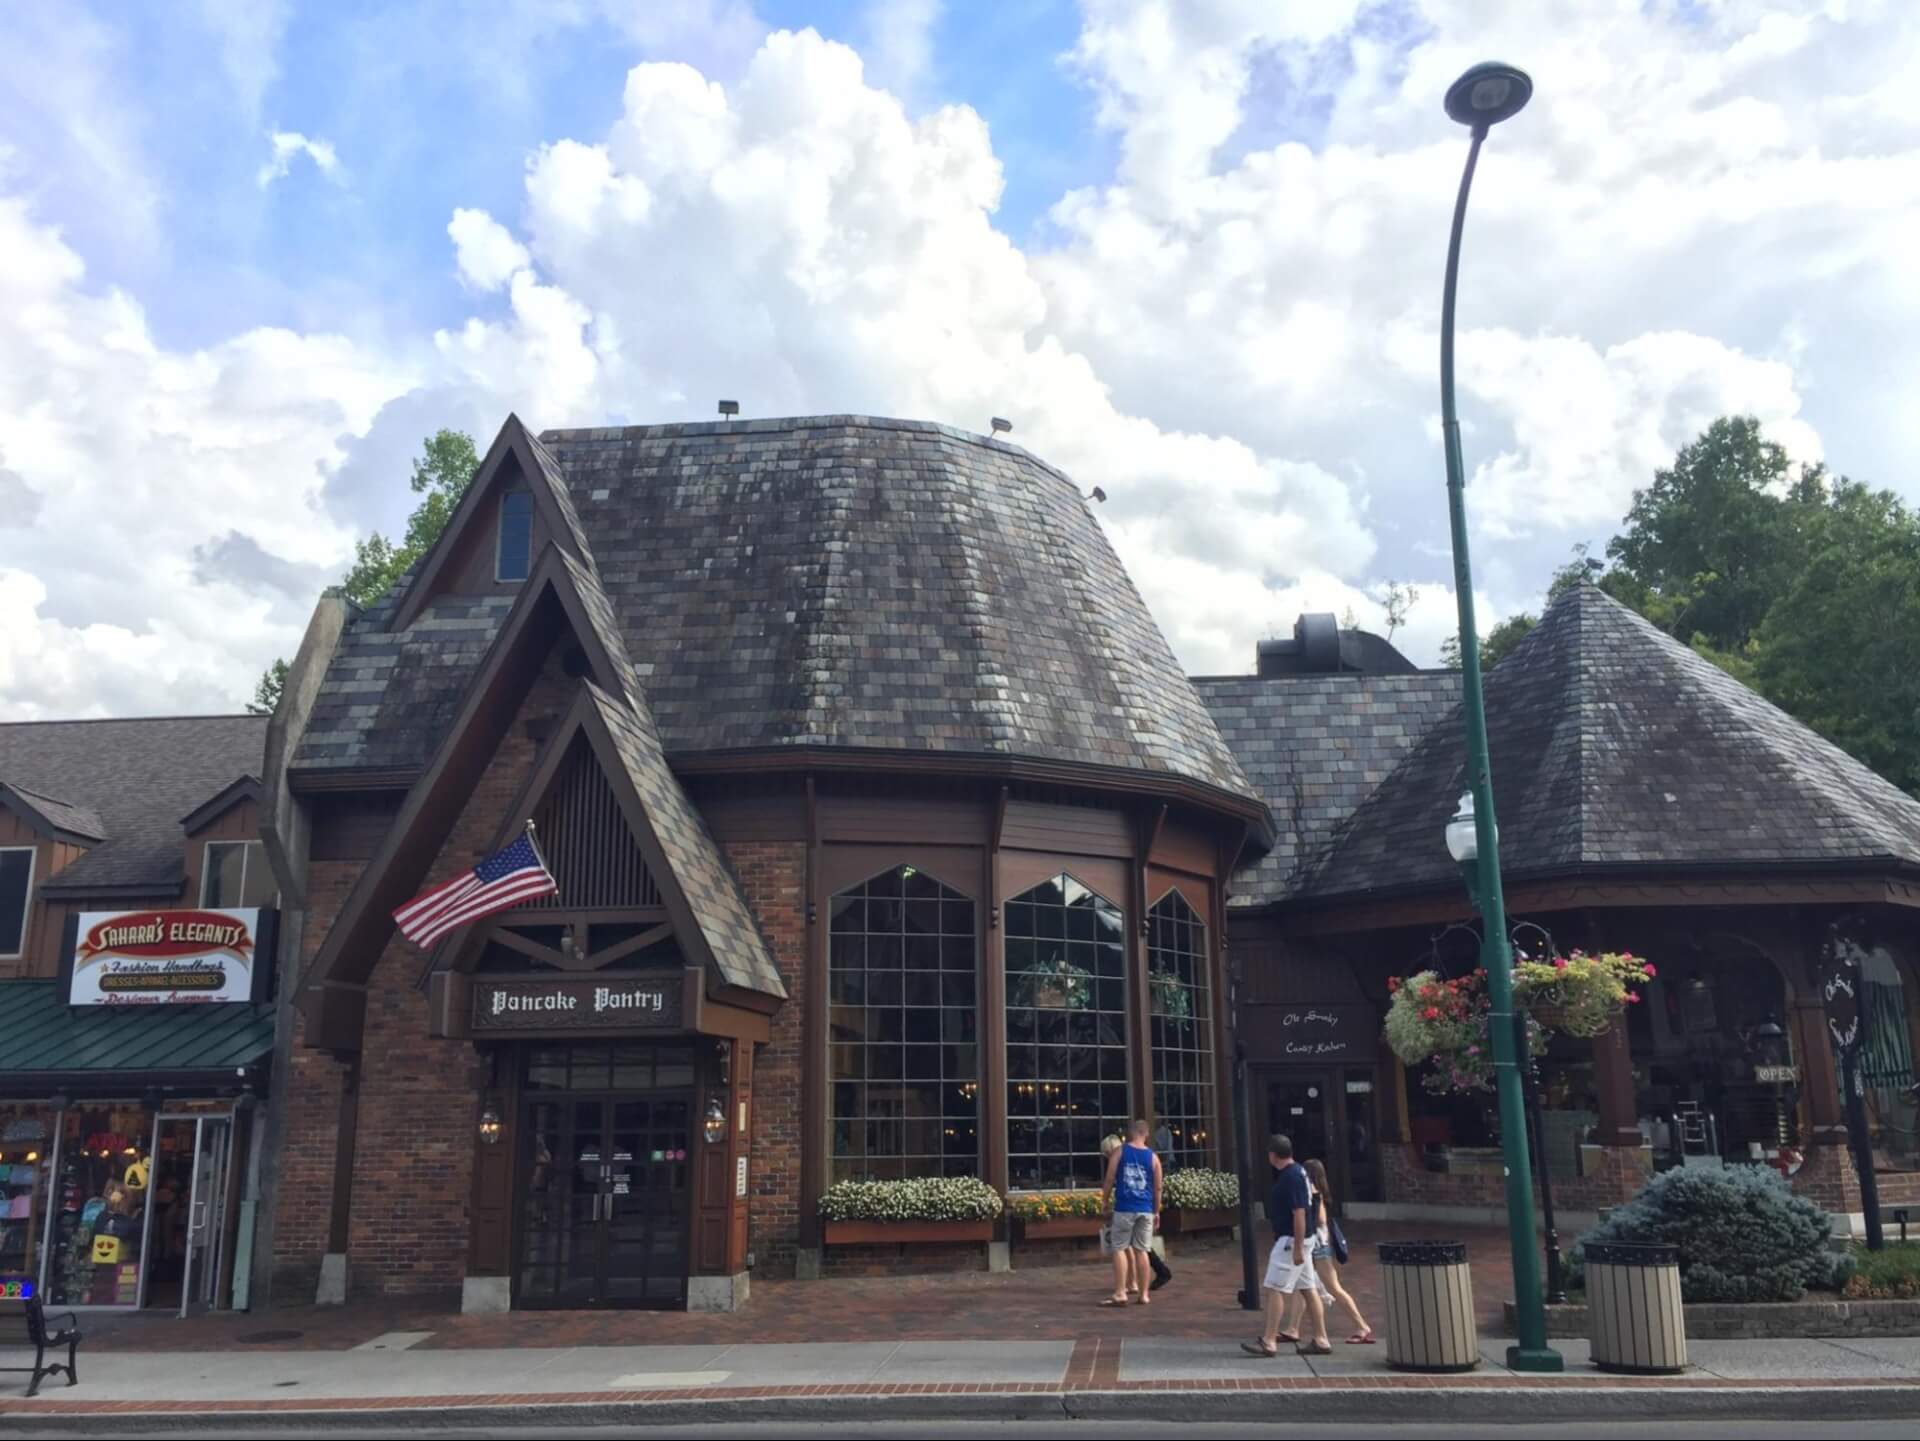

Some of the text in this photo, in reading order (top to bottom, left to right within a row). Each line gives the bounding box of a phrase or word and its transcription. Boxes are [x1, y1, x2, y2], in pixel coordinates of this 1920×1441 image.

[97, 916, 243, 950] SAHARA'S ELEGANTS
[111, 960, 160, 973] Fashion
[491, 987, 664, 1015] Pancake Pantry
[1759, 1067, 1797, 1081] OPEN
